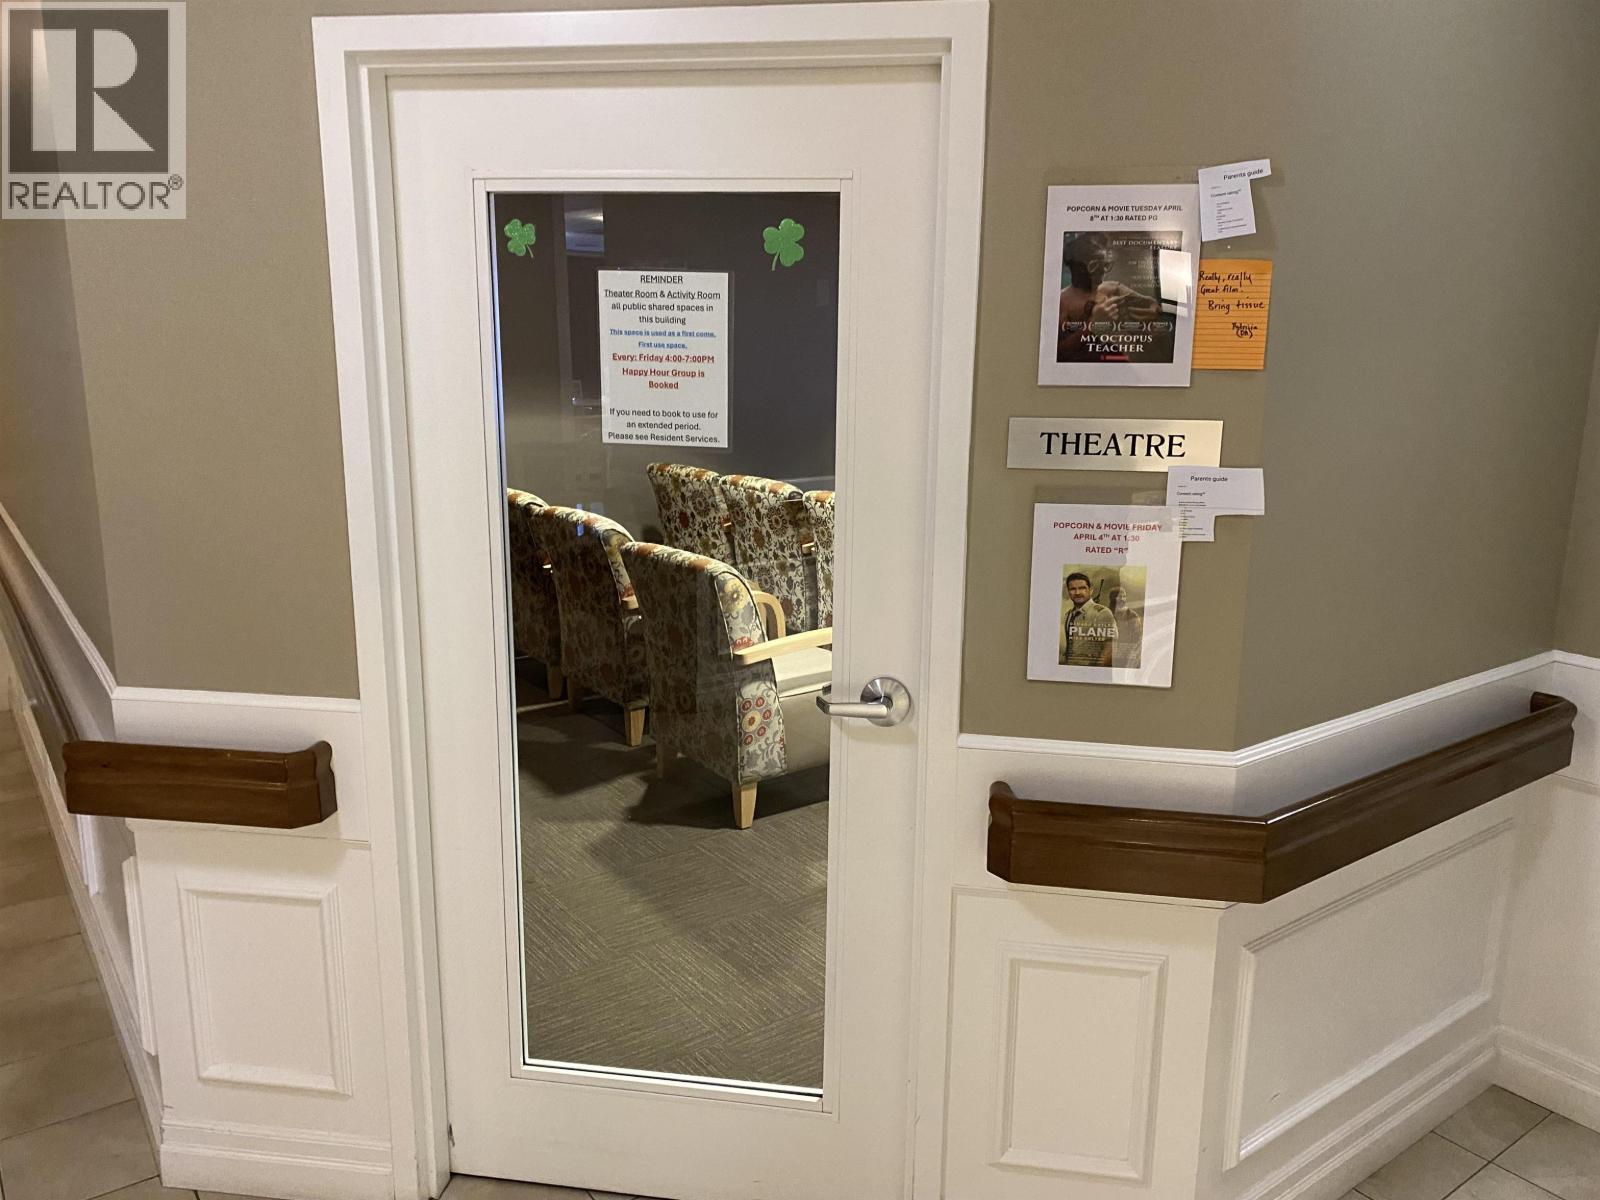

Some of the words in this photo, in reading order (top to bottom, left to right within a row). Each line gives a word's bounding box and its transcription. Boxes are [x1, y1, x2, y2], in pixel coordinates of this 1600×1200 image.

[1223, 172, 1246, 180] Parents
[1247, 168, 1264, 177] guide
[1108, 205, 1130, 213] MOVIE
[640, 274, 684, 284] REMINDER
[1228, 271, 1252, 285] really
[604, 289, 633, 298] Theater
[634, 290, 658, 299] Room
[659, 290, 666, 298] &
[667, 290, 696, 300] Activity
[697, 291, 721, 300] Room
[1200, 284, 1219, 295] Great
[611, 302, 621, 310] all
[622, 303, 647, 312] public
[648, 303, 675, 311] shared
[706, 303, 714, 312] in
[1208, 299, 1230, 315] Bring
[1236, 296, 1264, 309] tissue
[638, 315, 654, 323] this
[654, 316, 687, 326] building
[609, 328, 623, 336] This
[623, 330, 644, 338] space
[681, 329, 695, 337] first
[1080, 334, 1098, 343] MY
[1100, 334, 1153, 343] OCTOPUS
[638, 341, 652, 349] First
[1087, 343, 1144, 353] TEACHER
[612, 352, 637, 362] Every:
[638, 353, 663, 363] Friday
[664, 354, 715, 364] 4:00-7:00PM
[622, 367, 648, 377] Happy
[649, 368, 669, 377] Hour
[671, 369, 697, 379] Group
[697, 370, 705, 378] is
[648, 380, 679, 389] Booked
[609, 407, 615, 415] If
[616, 409, 630, 418] you
[631, 408, 651, 417] need
[652, 409, 660, 417] to
[661, 409, 681, 418] book
[682, 410, 691, 418] to
[692, 411, 706, 419] use
[707, 410, 719, 419] for
[637, 421, 673, 429] extended
[608, 431, 634, 440] Please
[634, 433, 649, 441] see
[650, 433, 684, 442] Resident
[685, 434, 720, 443] Services.
[1040, 431, 1186, 459] THEATRE
[1053, 522, 1095, 530] POPCORN
[1103, 522, 1130, 531] MOVIE
[1132, 523, 1163, 531] FRIDAY
[1073, 533, 1097, 541] APRIL
[1123, 534, 1140, 542] 1:30
[1085, 546, 1112, 554] RATED
[1069, 626, 1116, 638] PLANE
